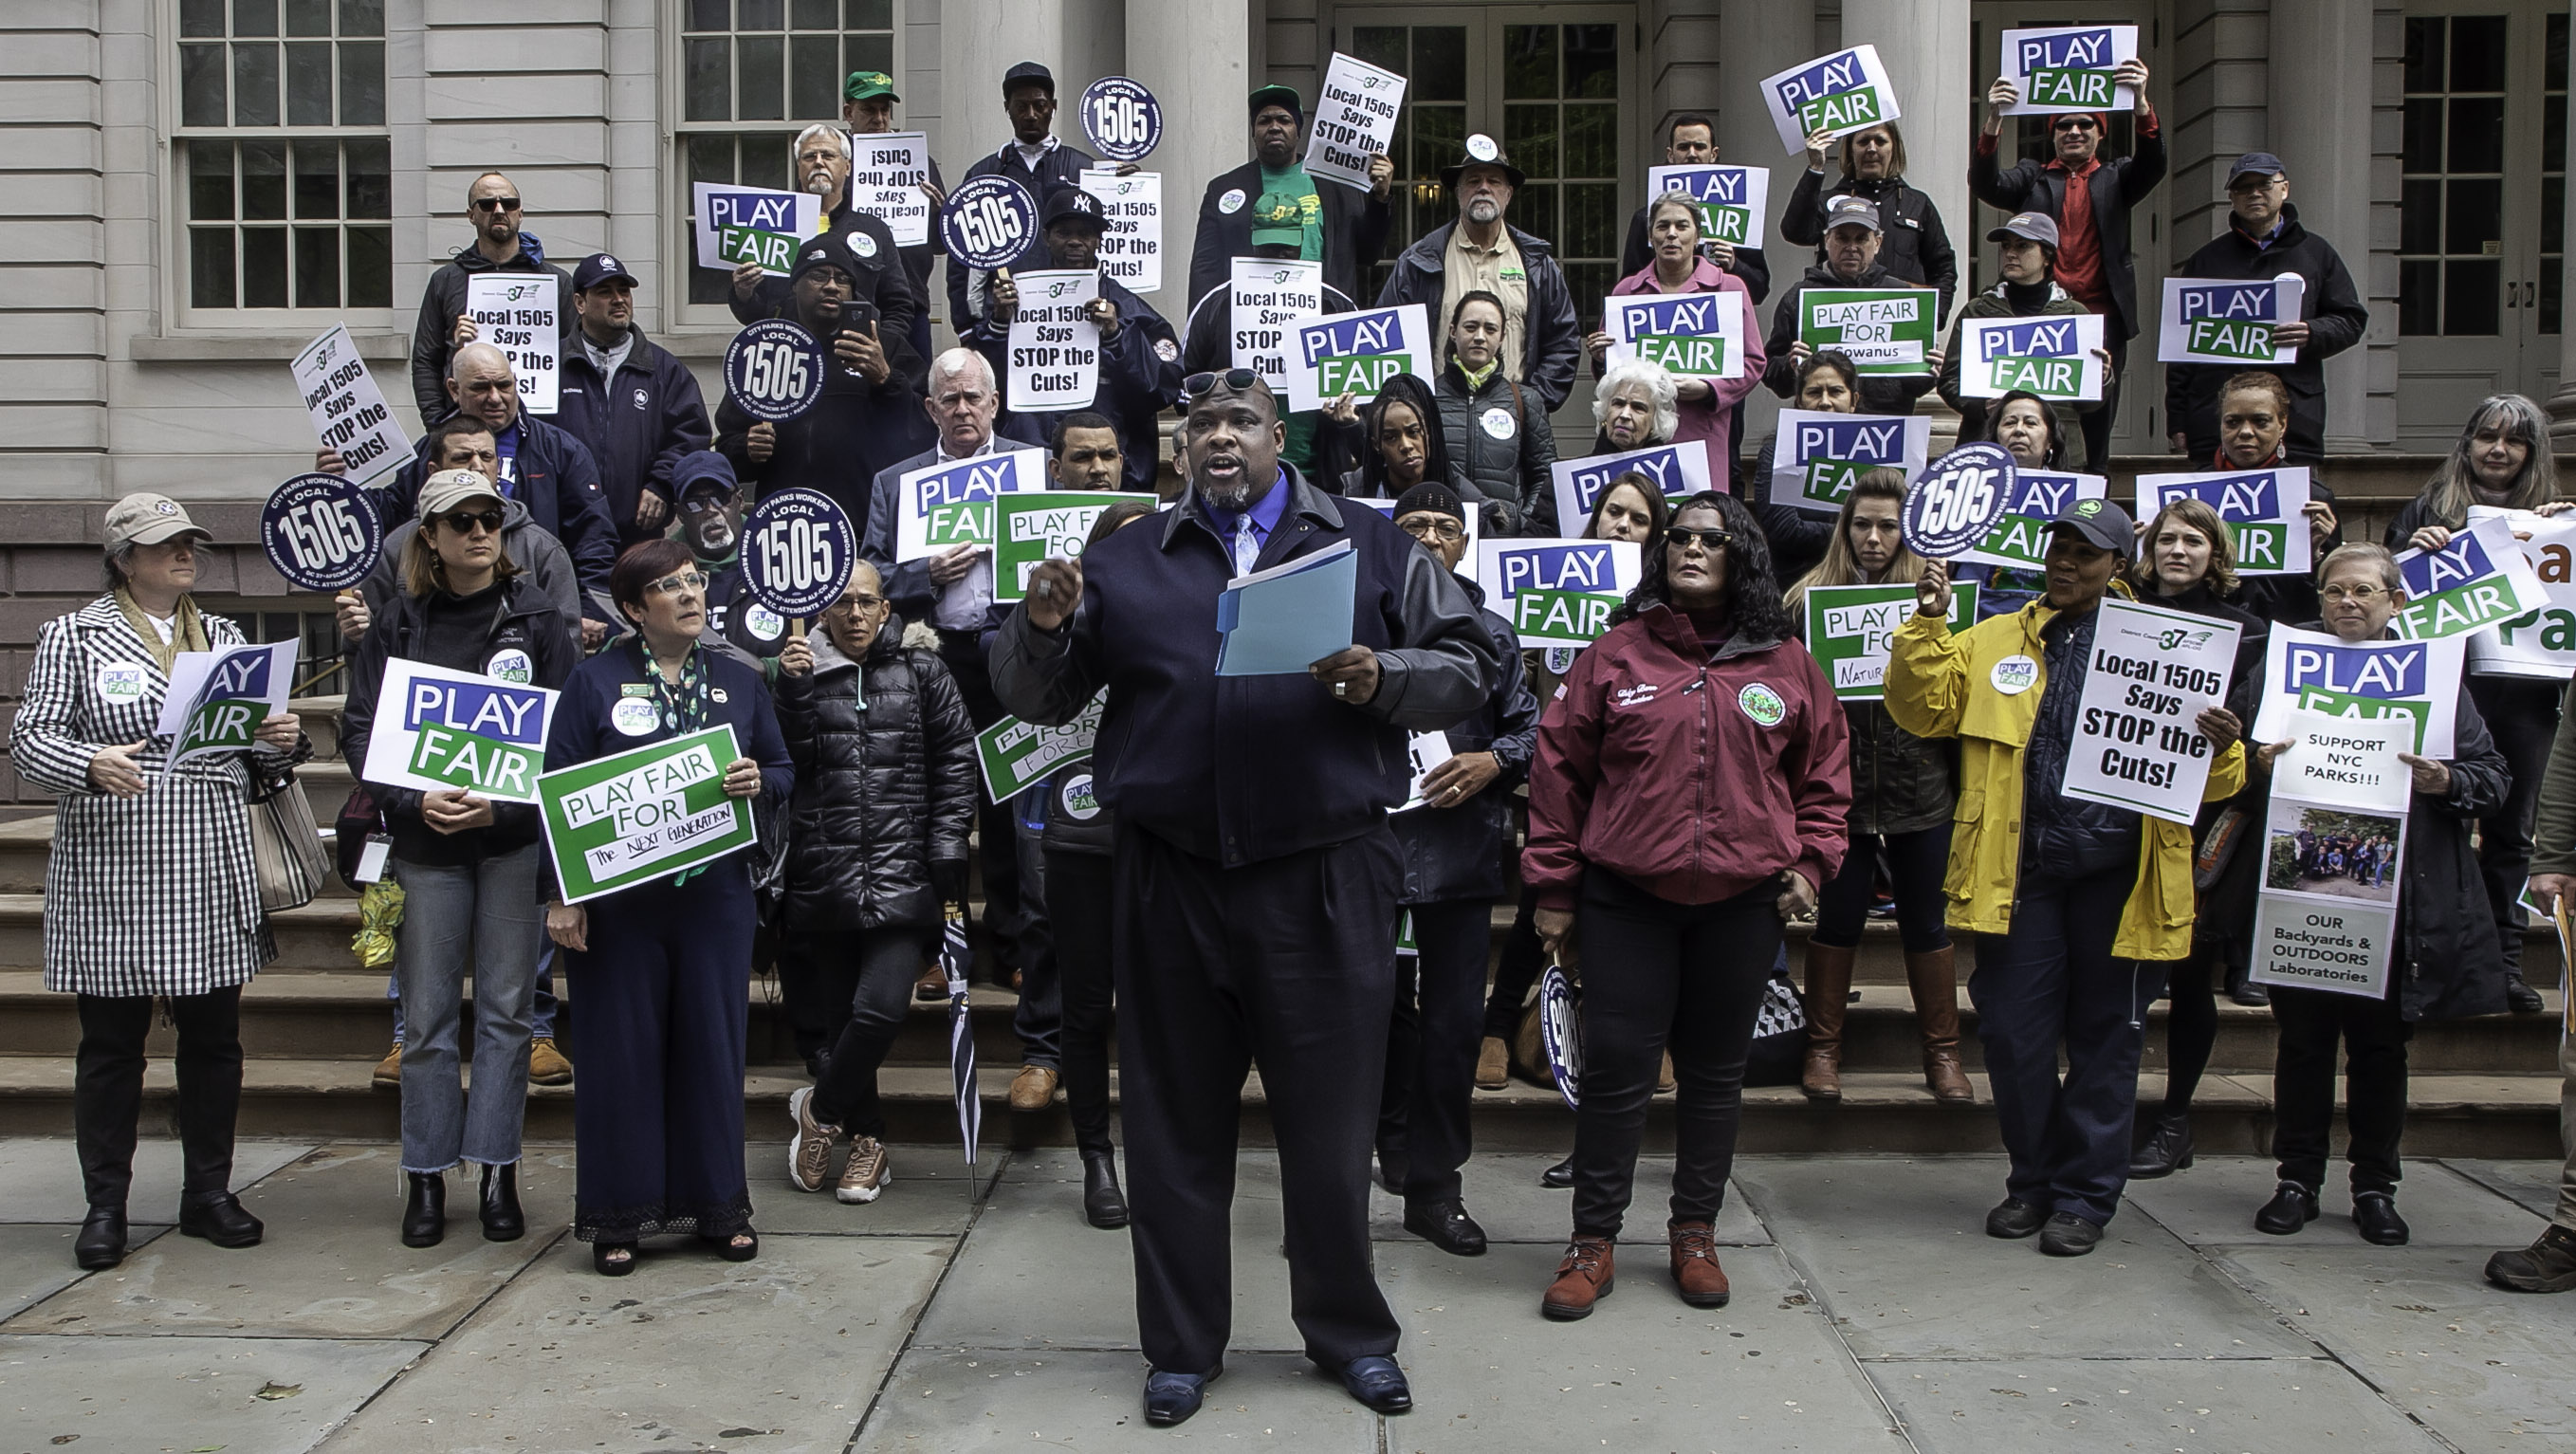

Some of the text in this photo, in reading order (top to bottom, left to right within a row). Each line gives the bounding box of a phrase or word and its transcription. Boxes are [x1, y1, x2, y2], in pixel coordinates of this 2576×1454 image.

[2023, 34, 2106, 71] PLAY
[1106, 87, 1136, 98] LOCAL
[1364, 77, 1379, 88] 37
[1782, 56, 1852, 110] PLAY
[2033, 72, 2107, 102] FAIR
[1325, 84, 1394, 119] Local 1505
[1094, 95, 1148, 144] 1505
[1341, 107, 1373, 128] Says
[1802, 94, 1875, 132] FAIR
[1316, 120, 1384, 153] STOP the
[872, 149, 911, 166] Cuts!
[1324, 146, 1367, 172] Cuts!
[858, 170, 925, 186] STOP the
[1118, 182, 1132, 194] 37
[1667, 174, 1741, 201] PLAY
[875, 191, 906, 204] Says
[963, 187, 998, 202] LOCAL
[711, 198, 791, 228] PLAY
[892, 206, 925, 218] Local
[1102, 202, 1156, 215] cal 1505
[953, 194, 1022, 252] 1505
[1108, 219, 1138, 233] Says
[1702, 208, 1740, 239] AIR
[723, 229, 791, 269] FAIR
[1131, 238, 1156, 254] the
[1101, 260, 1142, 276] Cuts!
[1275, 270, 1290, 284] 37
[506, 283, 522, 301] 37
[1049, 283, 1065, 298] 37
[1236, 291, 1316, 309] Local 1505
[1014, 305, 1092, 323] Local 1505
[1817, 303, 1913, 324] PLAY FAIR
[2185, 288, 2270, 320] PLAY
[514, 310, 553, 326] 1505
[1260, 309, 1296, 325] Says
[1627, 301, 1710, 338] PLAY
[494, 328, 531, 345] Says
[747, 326, 761, 336] CITY
[785, 324, 813, 344] WORKERS
[763, 332, 799, 346] LOCAL
[1037, 326, 1073, 342] Says
[1237, 331, 1281, 349] STOP
[1306, 316, 1394, 363] PLAY
[1845, 323, 1886, 342] FOR
[1985, 323, 2071, 357] PLAY
[2193, 322, 2270, 356] FAIR
[316, 349, 326, 371] 37
[522, 352, 553, 370] the
[1014, 347, 1094, 367] STOP the
[1640, 339, 1718, 371] FAIR
[743, 341, 809, 401] 1505
[1032, 372, 1078, 392] Cuts!
[1323, 359, 1401, 392] FAIR
[1996, 359, 2073, 391] FAIR
[305, 378, 332, 412] Local
[329, 359, 362, 391] 1505
[324, 391, 356, 419] Says
[752, 409, 788, 418] ATTENDENTS
[794, 404, 807, 414] PARK
[807, 384, 821, 405] SERVICE
[321, 403, 387, 449] STOP the
[342, 432, 390, 469] Cuts!
[1802, 425, 1898, 460] PLAY
[921, 461, 1009, 511] PLAY
[1811, 464, 1856, 496] FA
[271, 478, 344, 508] CITY PARKS WORKERS
[287, 488, 331, 506] LOCAL
[1918, 467, 1999, 535] 1505
[357, 493, 377, 524] WORKERS
[756, 493, 830, 518] CITY PARKS WORKERS
[772, 505, 815, 519] LOCAL
[278, 499, 365, 569] 1505
[1015, 512, 1071, 537] PLAY
[837, 520, 851, 555] WORKERS
[269, 546, 296, 578] REMOVERS
[364, 554, 376, 569] PARK
[756, 518, 833, 592] 1505
[322, 571, 362, 587] ATTENDENTS
[742, 558, 759, 594] REMOVERS
[838, 557, 850, 586] SERVICE
[1506, 549, 1607, 592] PLAY
[2401, 539, 2474, 601] LAY
[302, 578, 320, 587] N.Y.C.
[762, 597, 777, 610] N.Y.C.
[824, 586, 839, 602] PARK
[779, 601, 819, 614] ATTENDENTS
[1519, 594, 1611, 635] FAIR
[2403, 586, 2513, 639] FAIR
[755, 620, 776, 634] FAIR
[1829, 607, 1889, 633] PLAY
[2159, 629, 2188, 651] 37
[494, 657, 522, 672] PLAY
[1841, 663, 1883, 685] NATUR
[1999, 665, 2032, 675] PLAY
[2095, 649, 2221, 695] Local 1505
[2292, 650, 2419, 693] PLAY
[104, 672, 138, 682] PLAY
[500, 672, 526, 681] FAIR
[2000, 674, 2028, 685] FAIR
[107, 683, 139, 693] FAIR
[412, 684, 538, 736] PLAY
[619, 706, 651, 715] PLAY
[2125, 685, 2182, 715] Says
[184, 706, 250, 750] AIR
[624, 716, 654, 727] FAIR
[1041, 719, 1097, 741] FOR
[2084, 708, 2207, 758] STOP the
[2309, 734, 2385, 751] SUPPORT
[416, 729, 528, 792] FAIR
[2101, 748, 2177, 789] Cuts!
[2327, 753, 2363, 767] NYC
[2305, 766, 2380, 785] PARKS!!!
[567, 753, 710, 823] PLAY FAIR
[1068, 784, 1092, 800] PLAY
[1074, 797, 1097, 809] FAIR
[618, 800, 682, 832] FOR
[589, 804, 730, 866] The NEXT GENERATION
[2306, 915, 2344, 929] OUR
[2273, 928, 2370, 949] Backyards &
[2272, 945, 2368, 966] OUTDOORS
[2270, 961, 2367, 983] Laboratories
